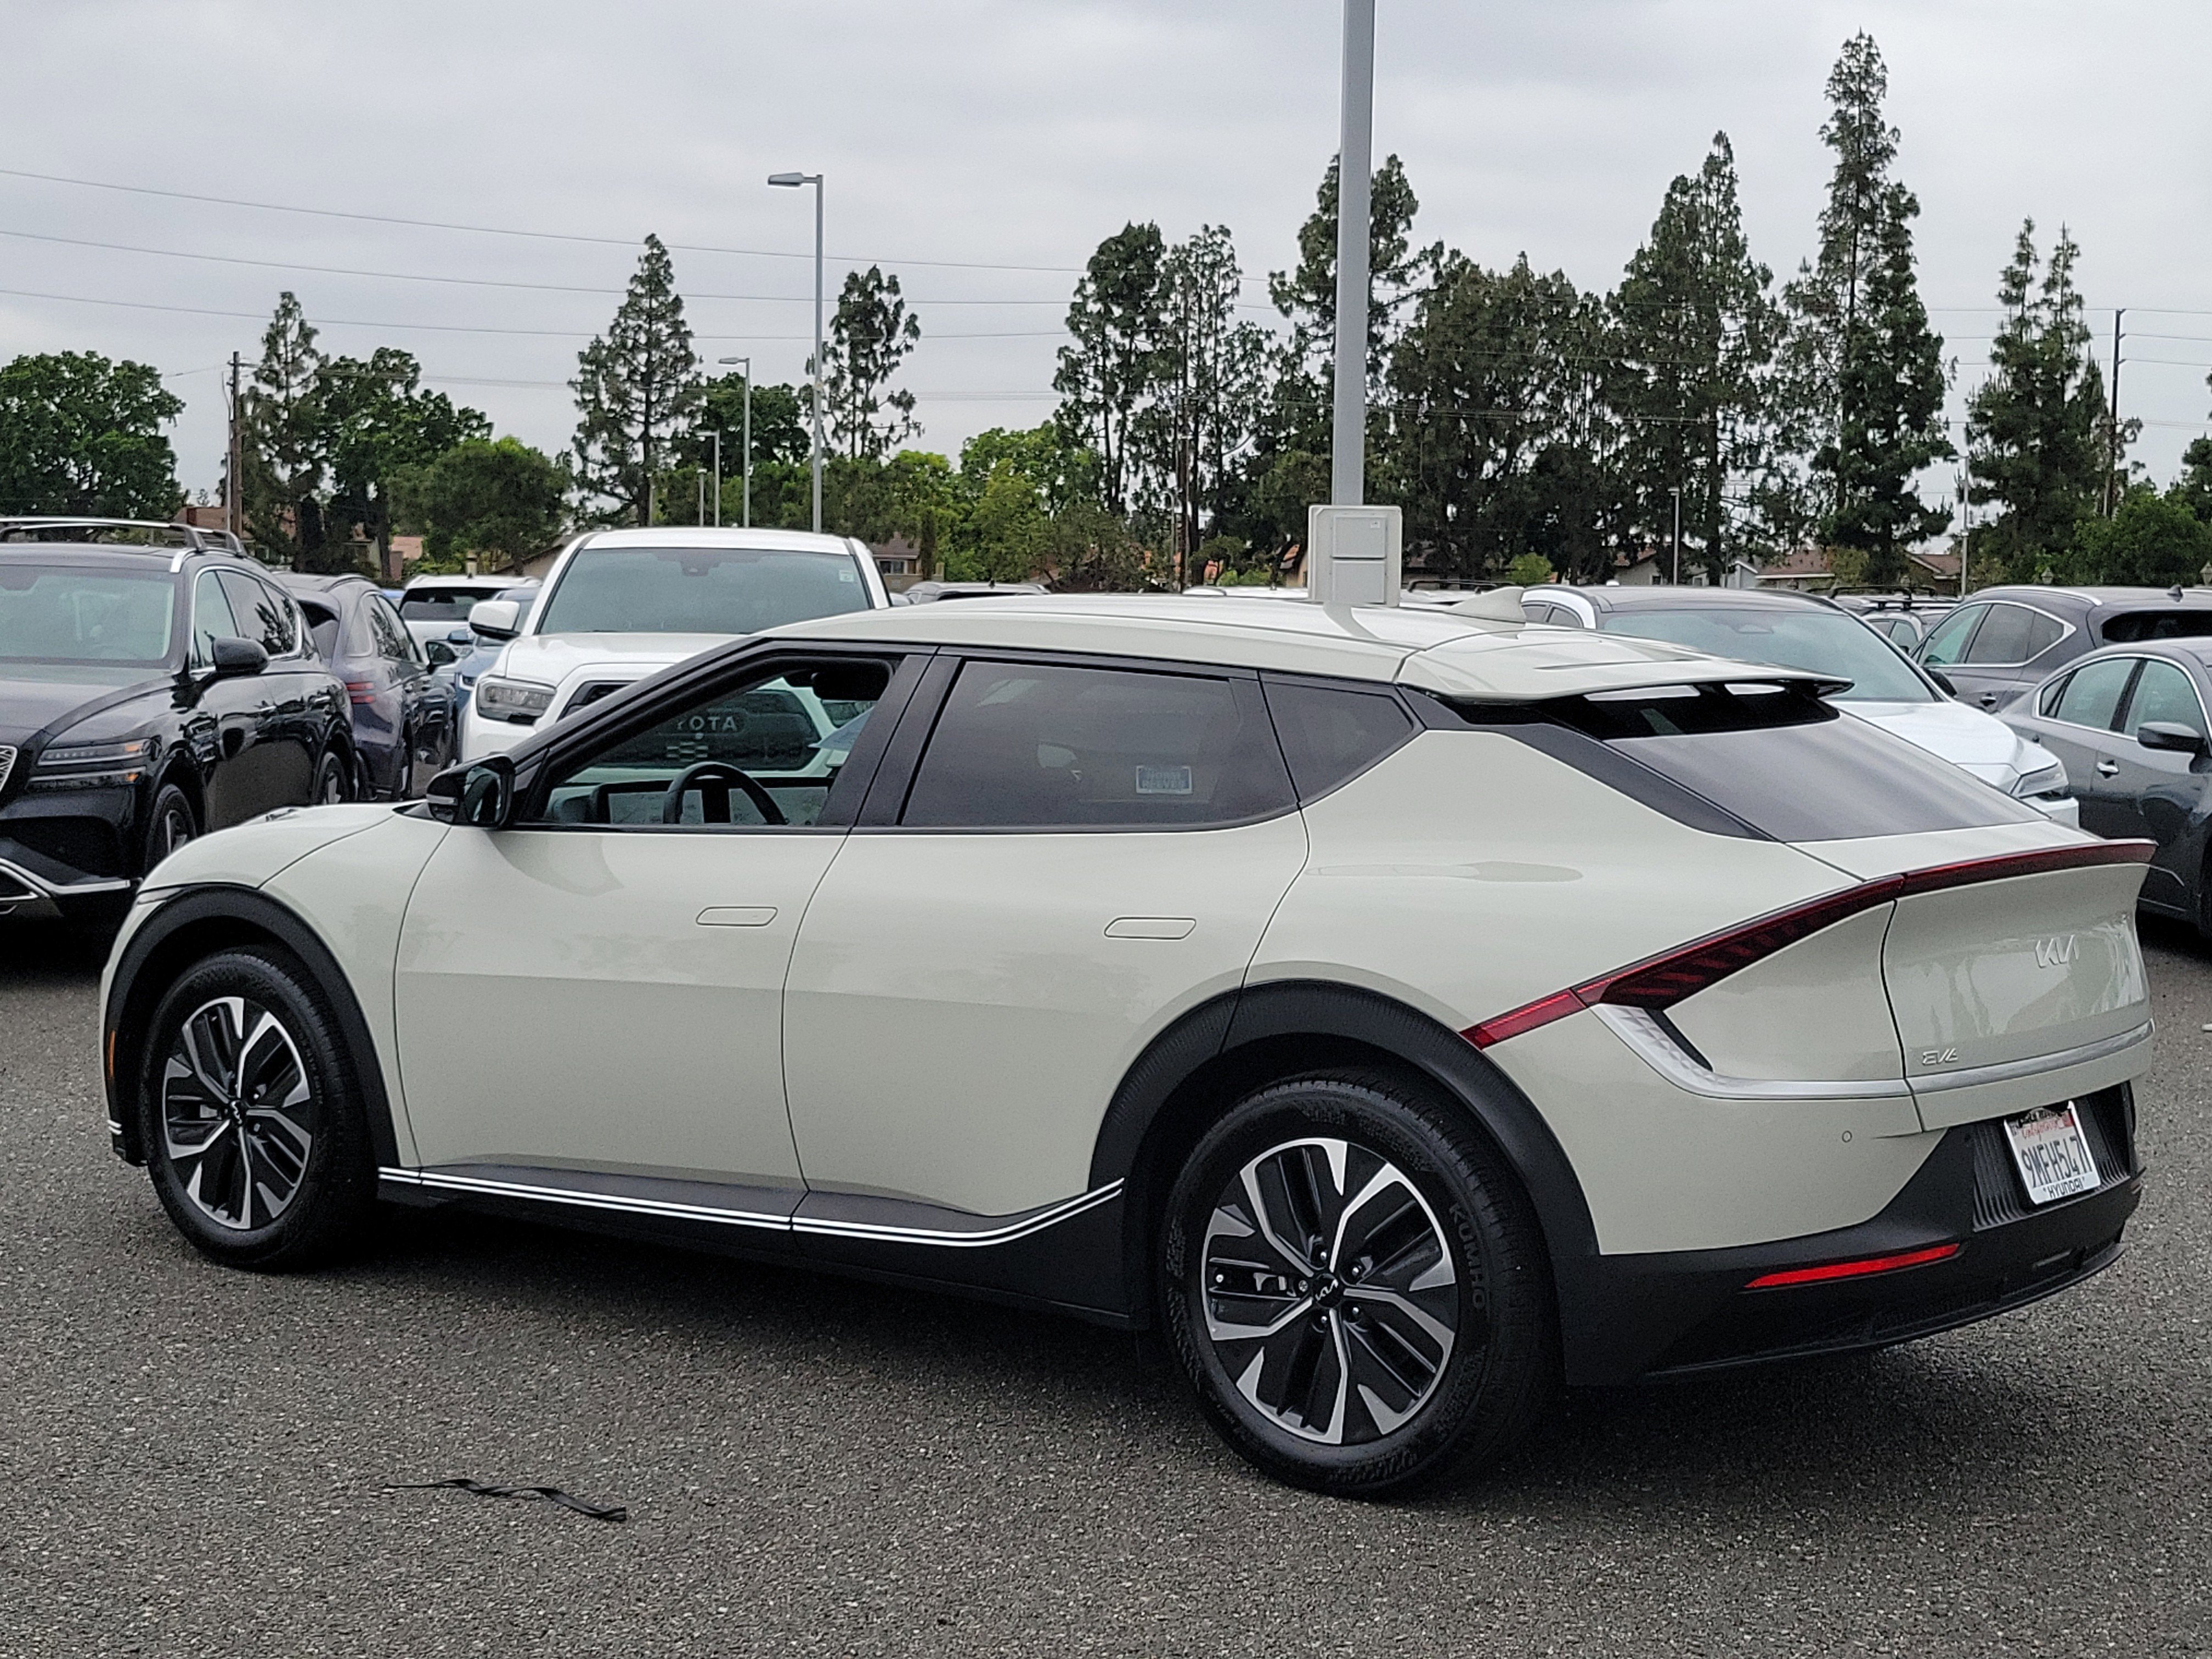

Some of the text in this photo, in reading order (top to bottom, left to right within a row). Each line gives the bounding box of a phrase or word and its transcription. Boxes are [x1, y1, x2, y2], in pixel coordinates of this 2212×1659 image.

[677, 715, 737, 731] YOTA
[1921, 1047, 1959, 1066] EV6
[1449, 1202, 1486, 1311] KUMHO
